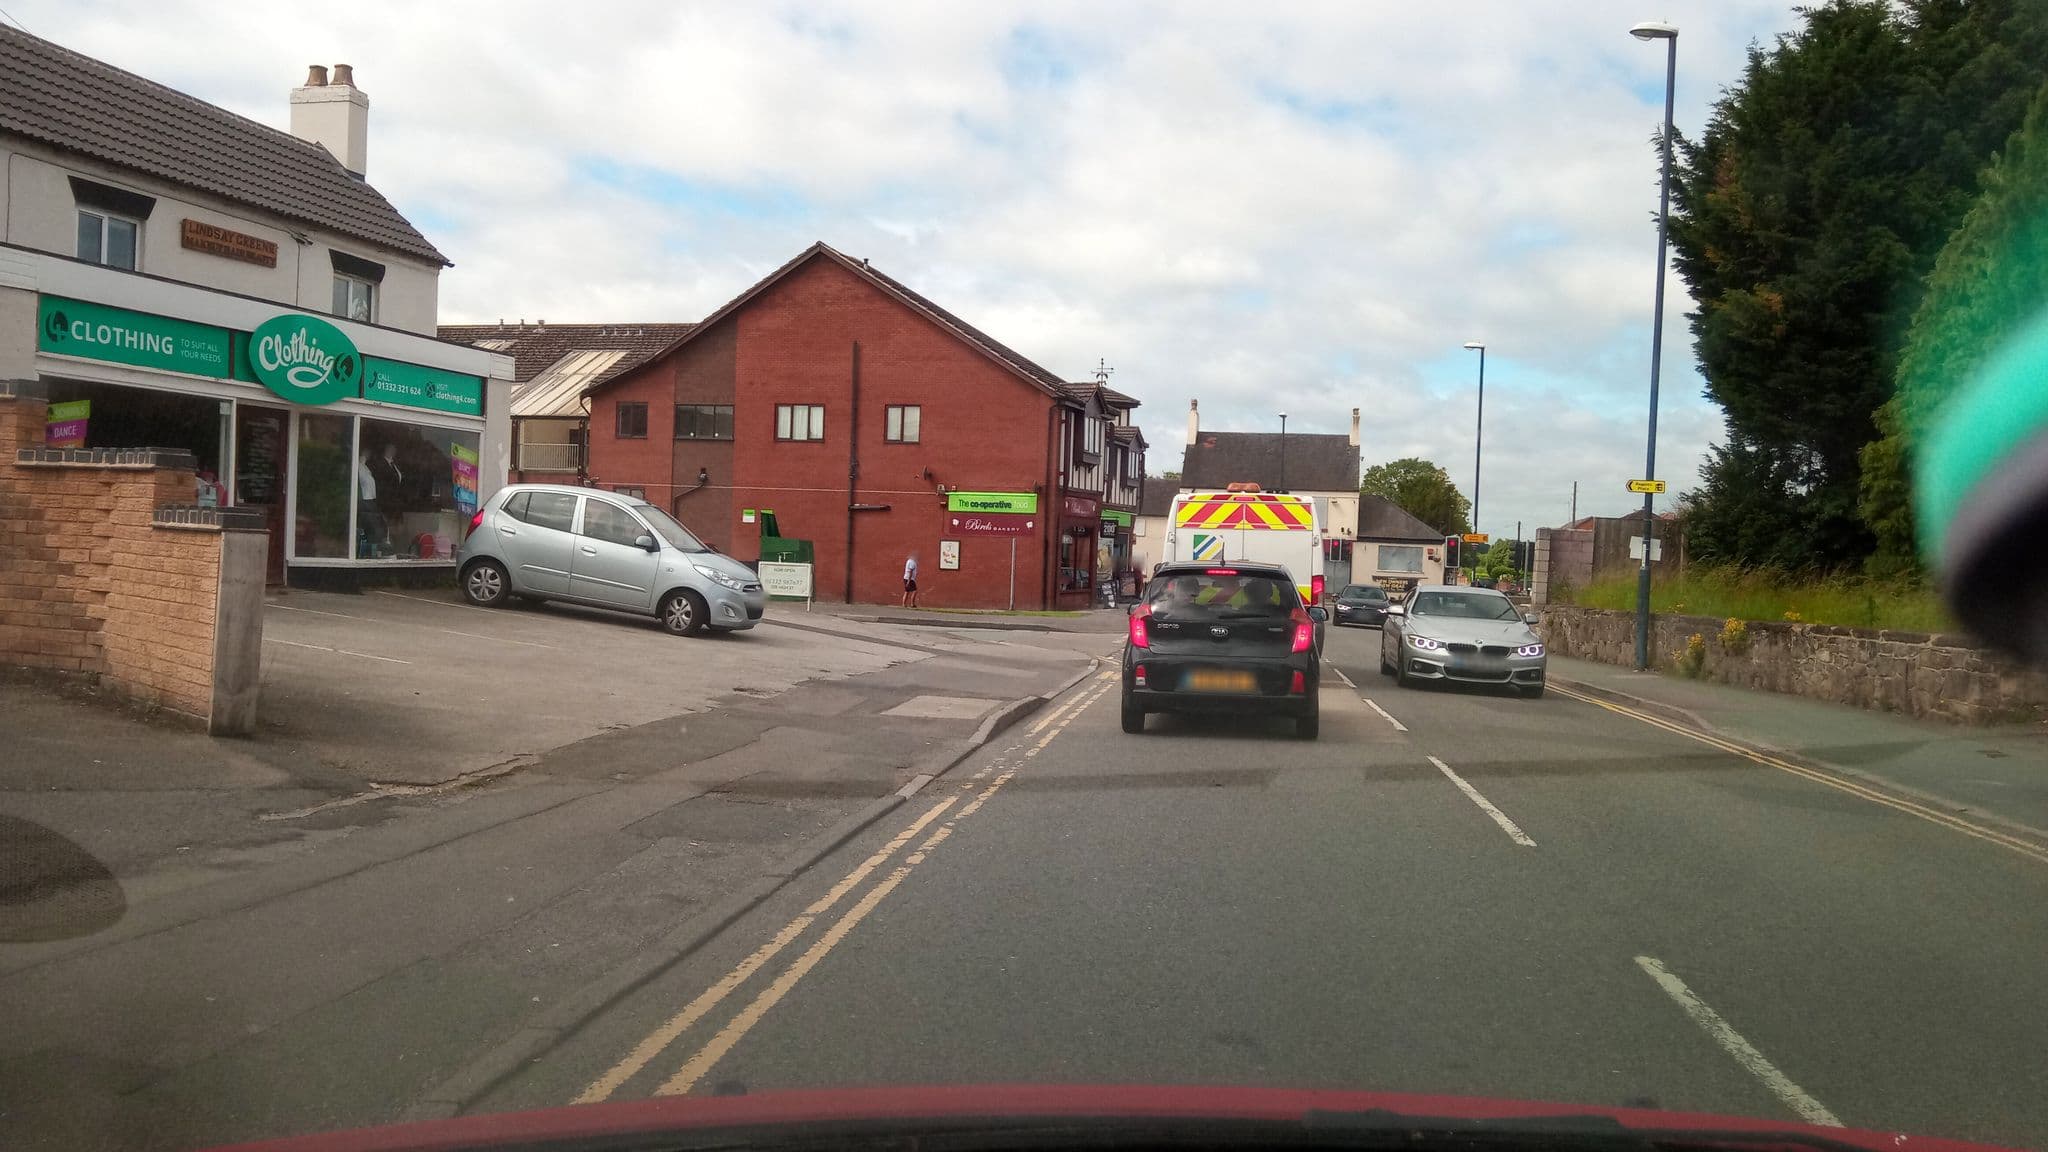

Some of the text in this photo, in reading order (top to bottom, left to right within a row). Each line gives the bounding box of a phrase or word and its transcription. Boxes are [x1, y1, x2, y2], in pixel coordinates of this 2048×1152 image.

[71, 320, 174, 355] CLOTHING
[180, 338, 218, 353] TO SUIT ALL
[180, 350, 222, 364] YOUR NEEDS
[258, 327, 336, 388] Clothing
[377, 381, 421, 395] 01332 321 624
[54, 425, 77, 438] DANCE
[958, 499, 970, 508] The
[970, 500, 1012, 509] co-operative
[964, 518, 993, 531] Birds
